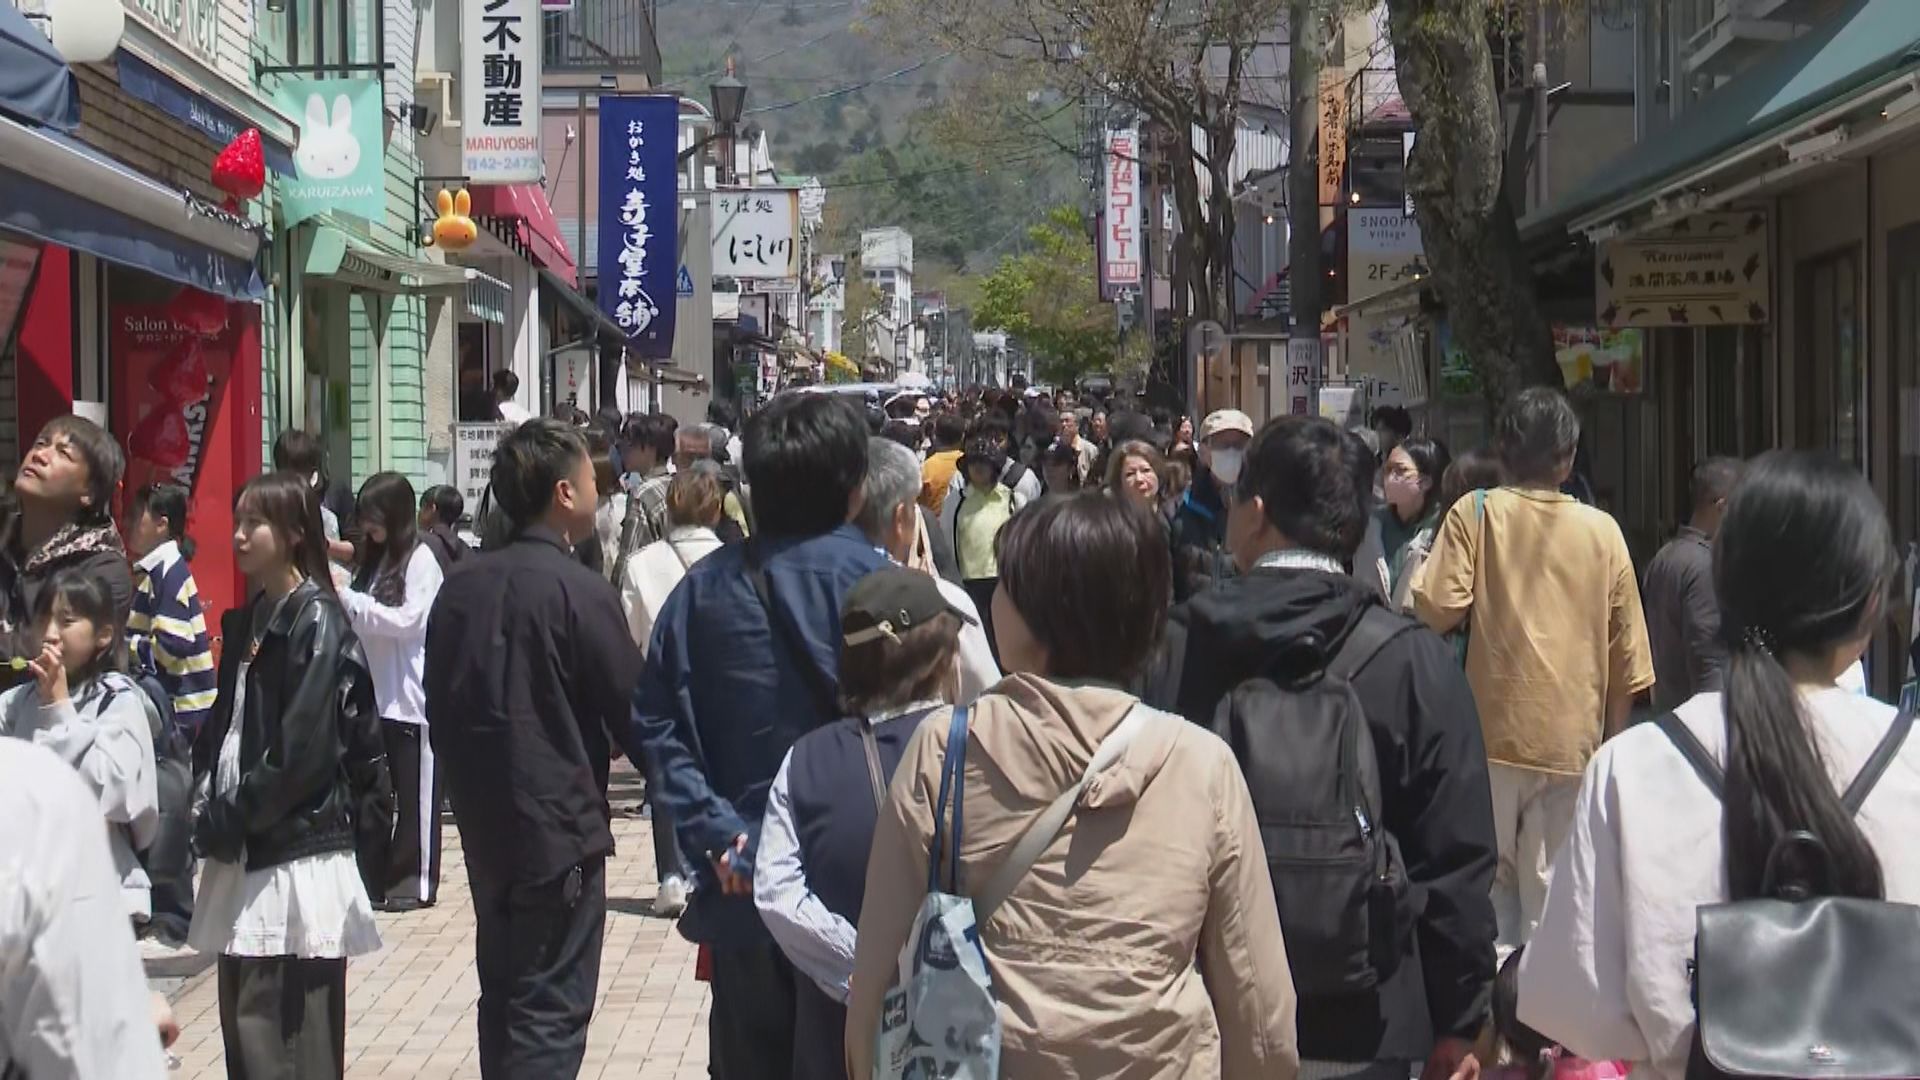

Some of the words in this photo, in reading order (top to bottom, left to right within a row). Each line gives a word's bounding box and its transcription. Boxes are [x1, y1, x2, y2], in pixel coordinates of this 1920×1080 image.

[466, 136, 538, 151] MARUYOSHI
[626, 120, 646, 181] おかき処
[289, 184, 373, 198] KARUIZAWA
[1111, 138, 1132, 259] ミカドコーヒー
[720, 198, 773, 213] そば処
[1360, 216, 1416, 227] SNOOPY
[729, 234, 793, 266] にし川
[1368, 264, 1390, 279] 2F
[124, 316, 168, 331] Salon
